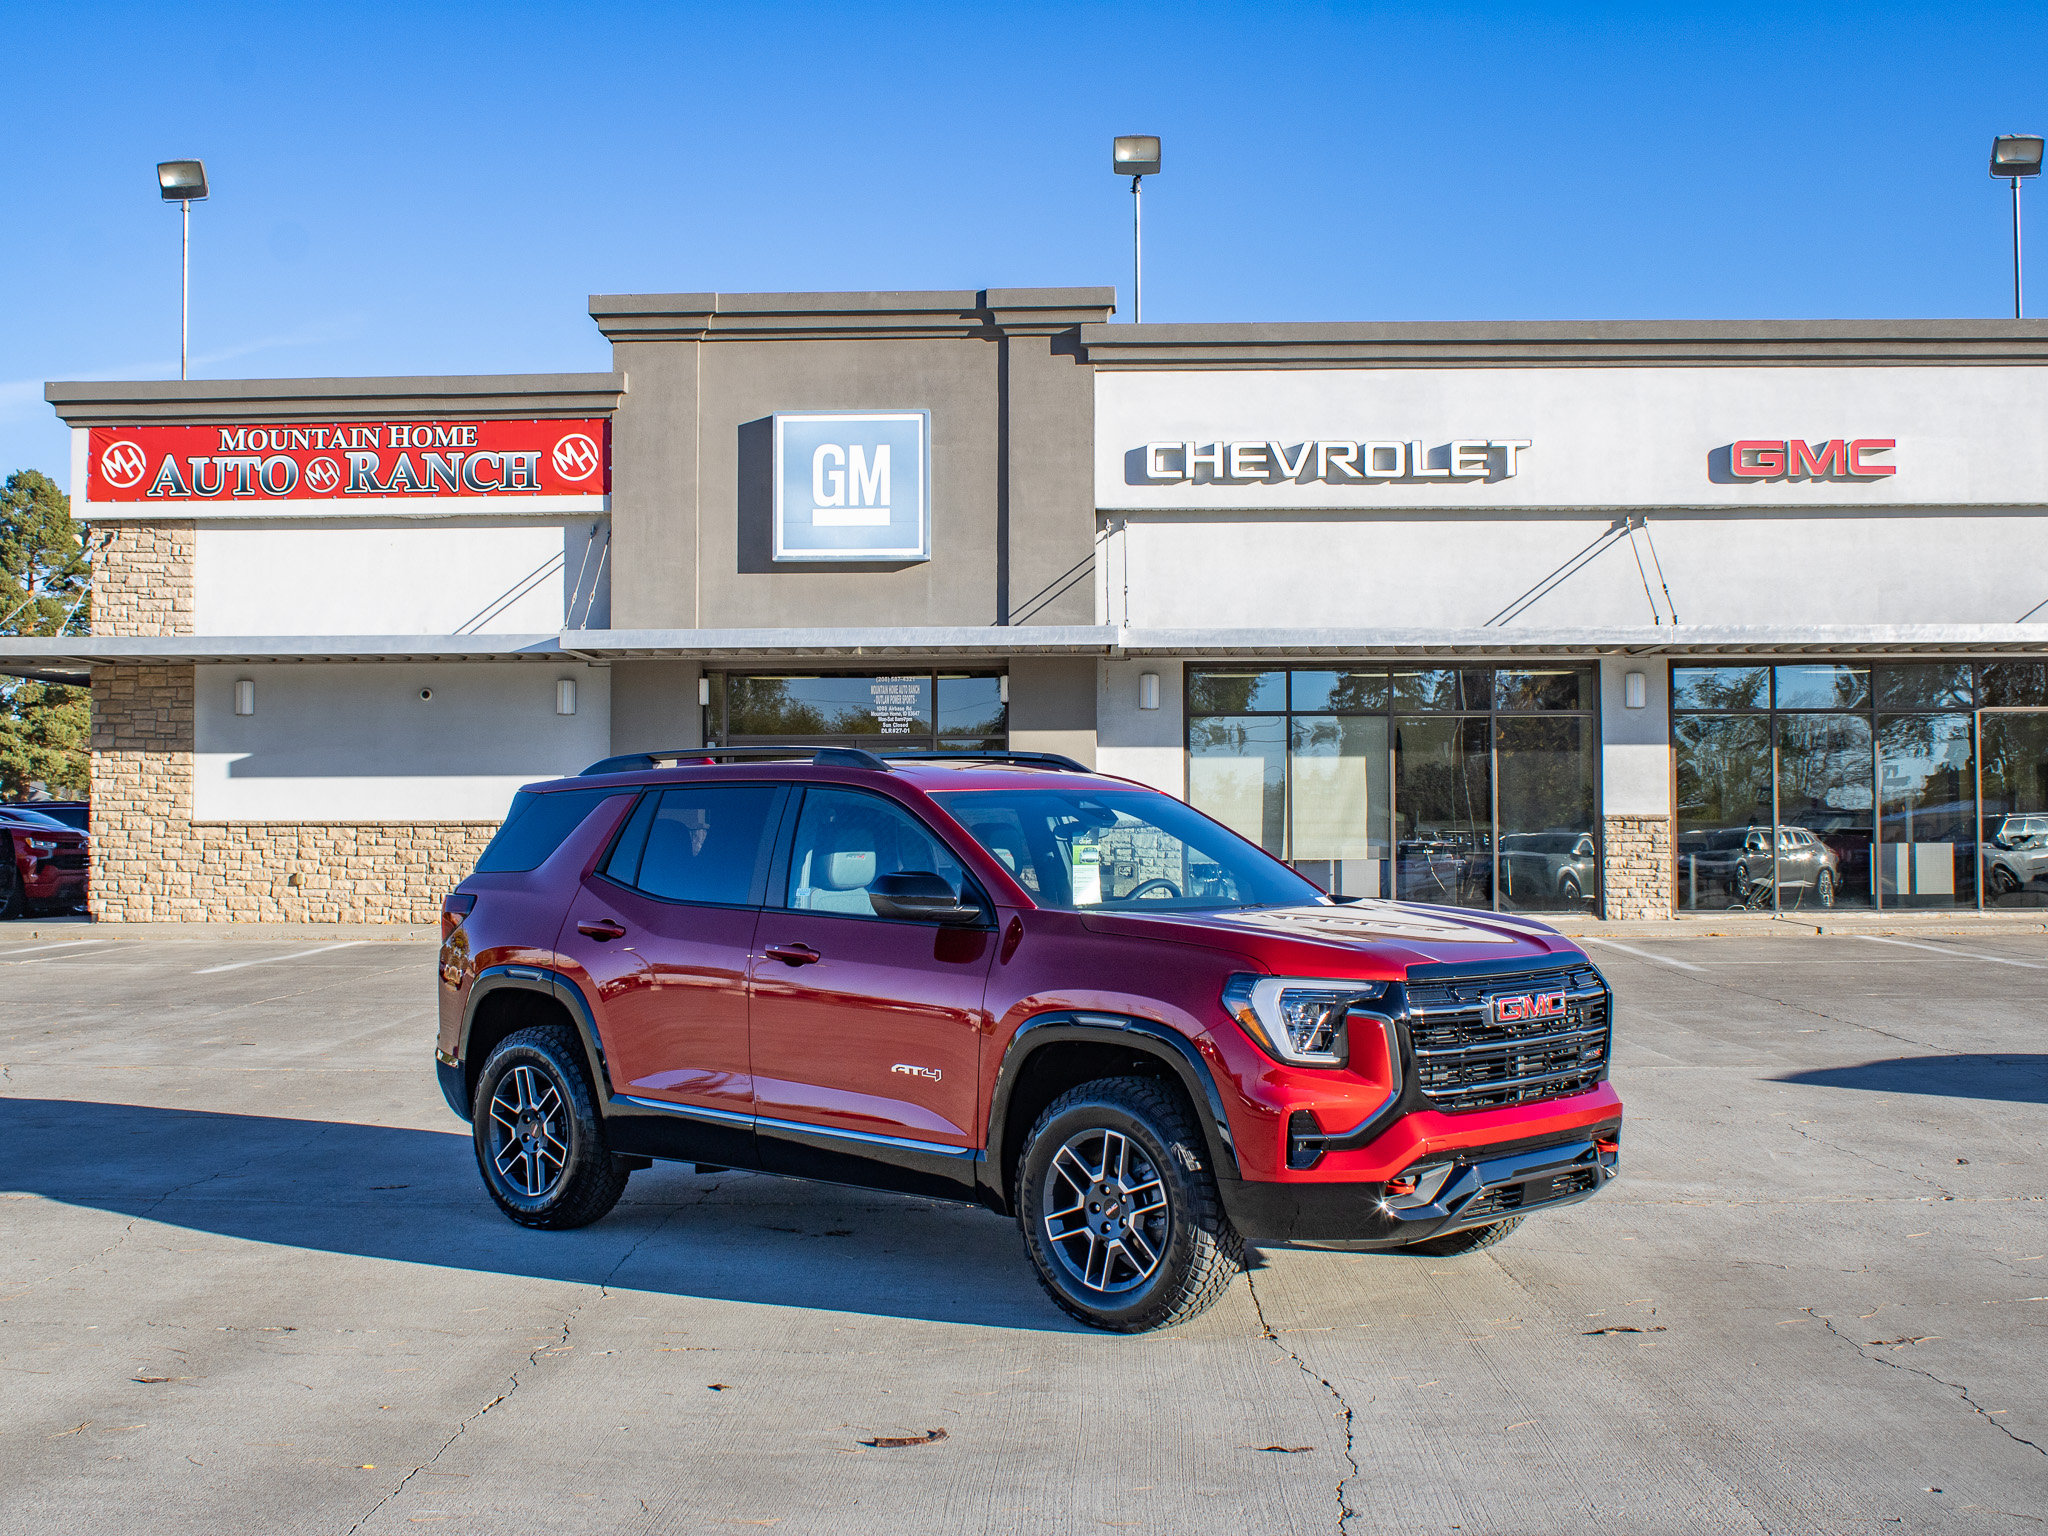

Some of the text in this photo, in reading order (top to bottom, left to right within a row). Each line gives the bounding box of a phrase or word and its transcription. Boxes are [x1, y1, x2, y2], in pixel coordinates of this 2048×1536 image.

[217, 424, 479, 452] MOUNTAIN HOME
[1145, 439, 1533, 479] CHEVROLET
[1730, 439, 1896, 476] GMC
[146, 452, 300, 497] AUTO
[343, 449, 543, 494] RANCH
[812, 443, 891, 508] GM
[870, 685, 921, 695] MOUNTAIN HOME AUTO RANCH
[890, 695, 901, 705] POWER
[1498, 991, 1567, 1021] GMC
[890, 1063, 942, 1082] AT4
